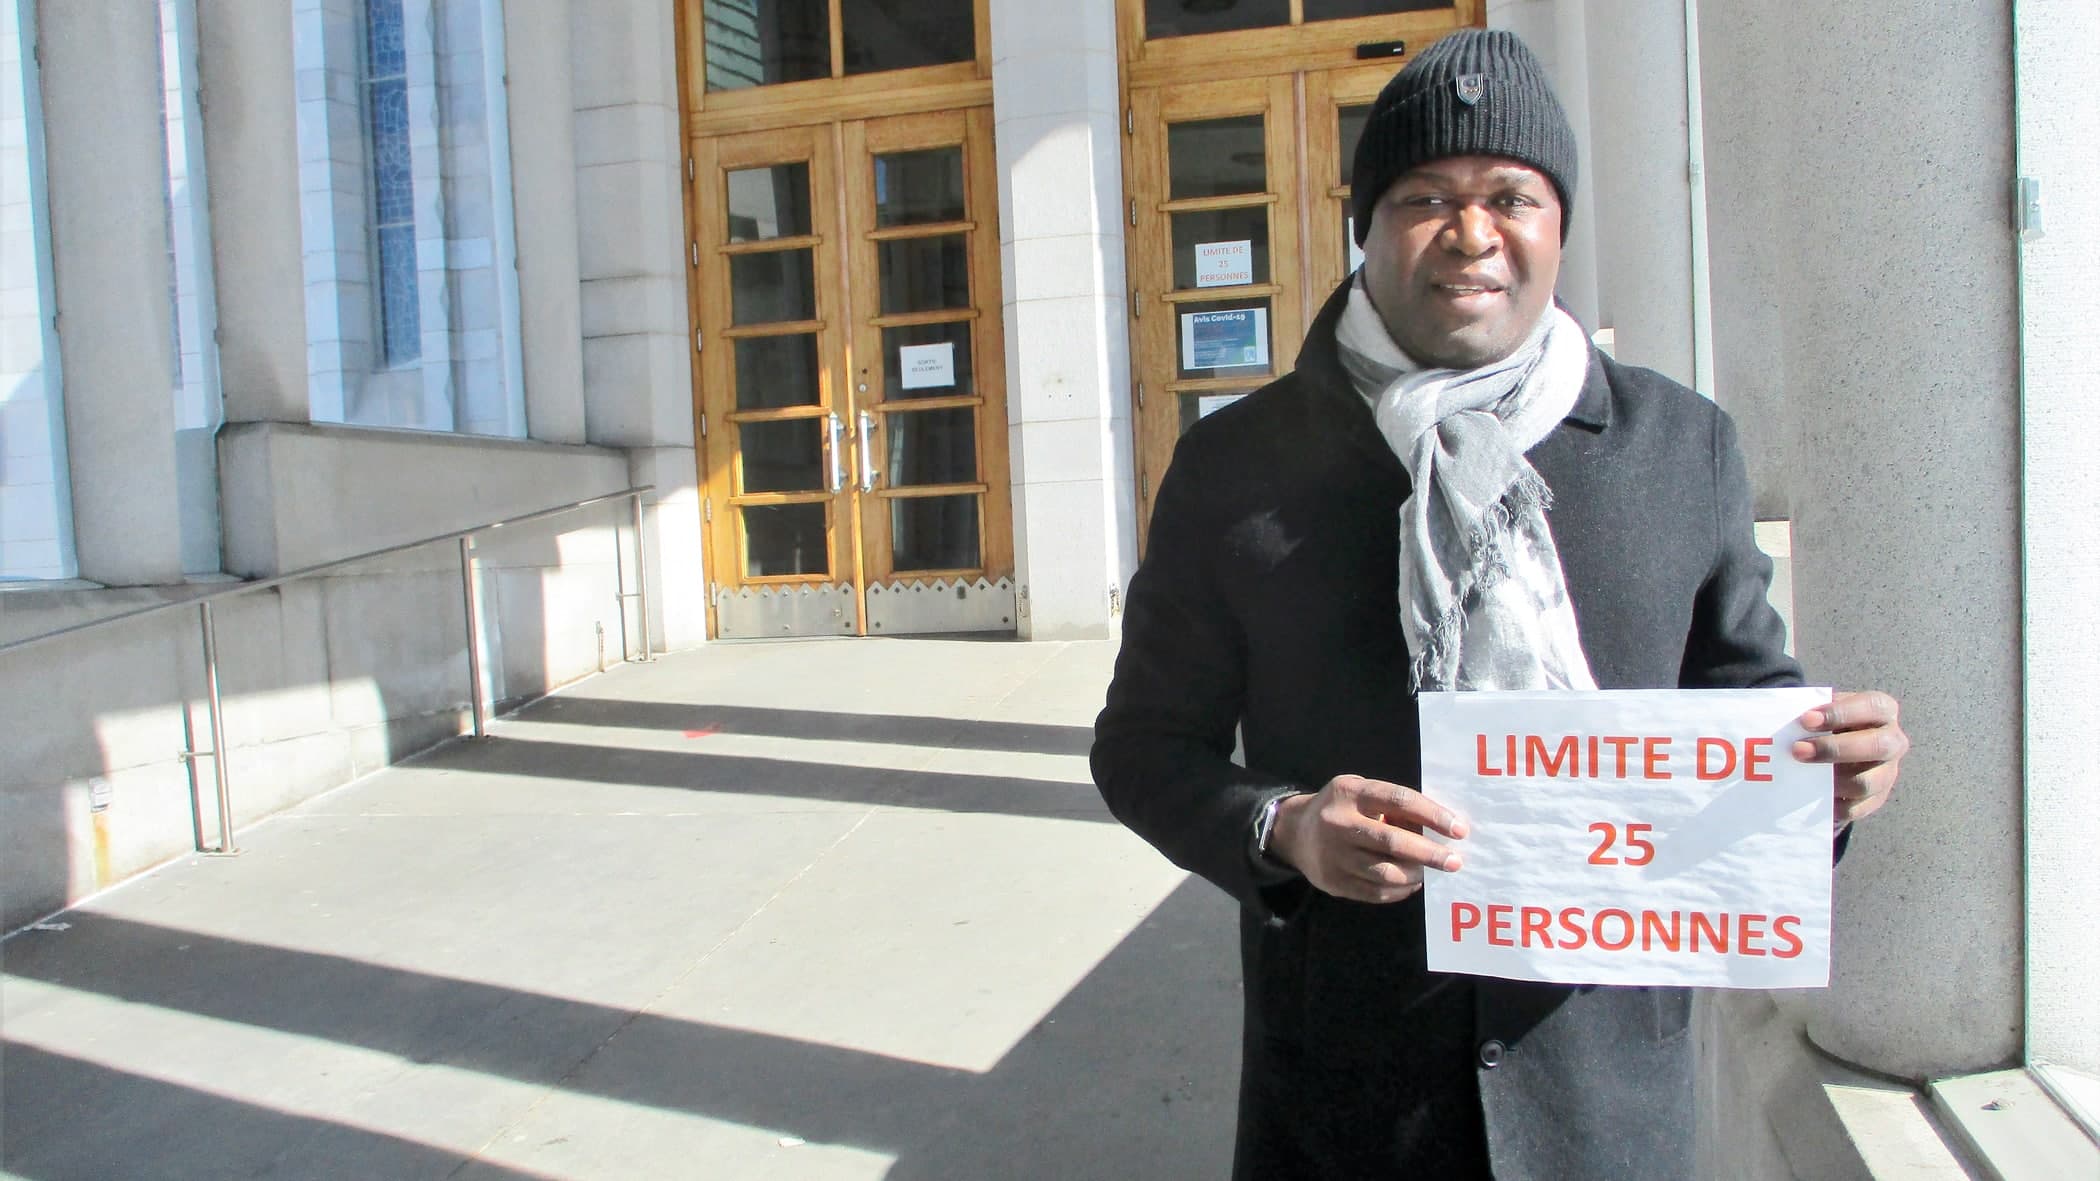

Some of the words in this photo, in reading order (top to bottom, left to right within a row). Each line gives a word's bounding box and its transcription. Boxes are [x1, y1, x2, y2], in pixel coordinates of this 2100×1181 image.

[1203, 247, 1231, 257] LIMITE
[1232, 246, 1244, 255] DE
[1218, 260, 1228, 268] 25
[1200, 272, 1249, 282] PERSONNES
[1211, 313, 1246, 322] Covid-19
[1475, 734, 1673, 780] LIMITE
[1696, 737, 1774, 782] DE
[1587, 822, 1656, 866] 25
[1450, 902, 1804, 959] PERSONNES
